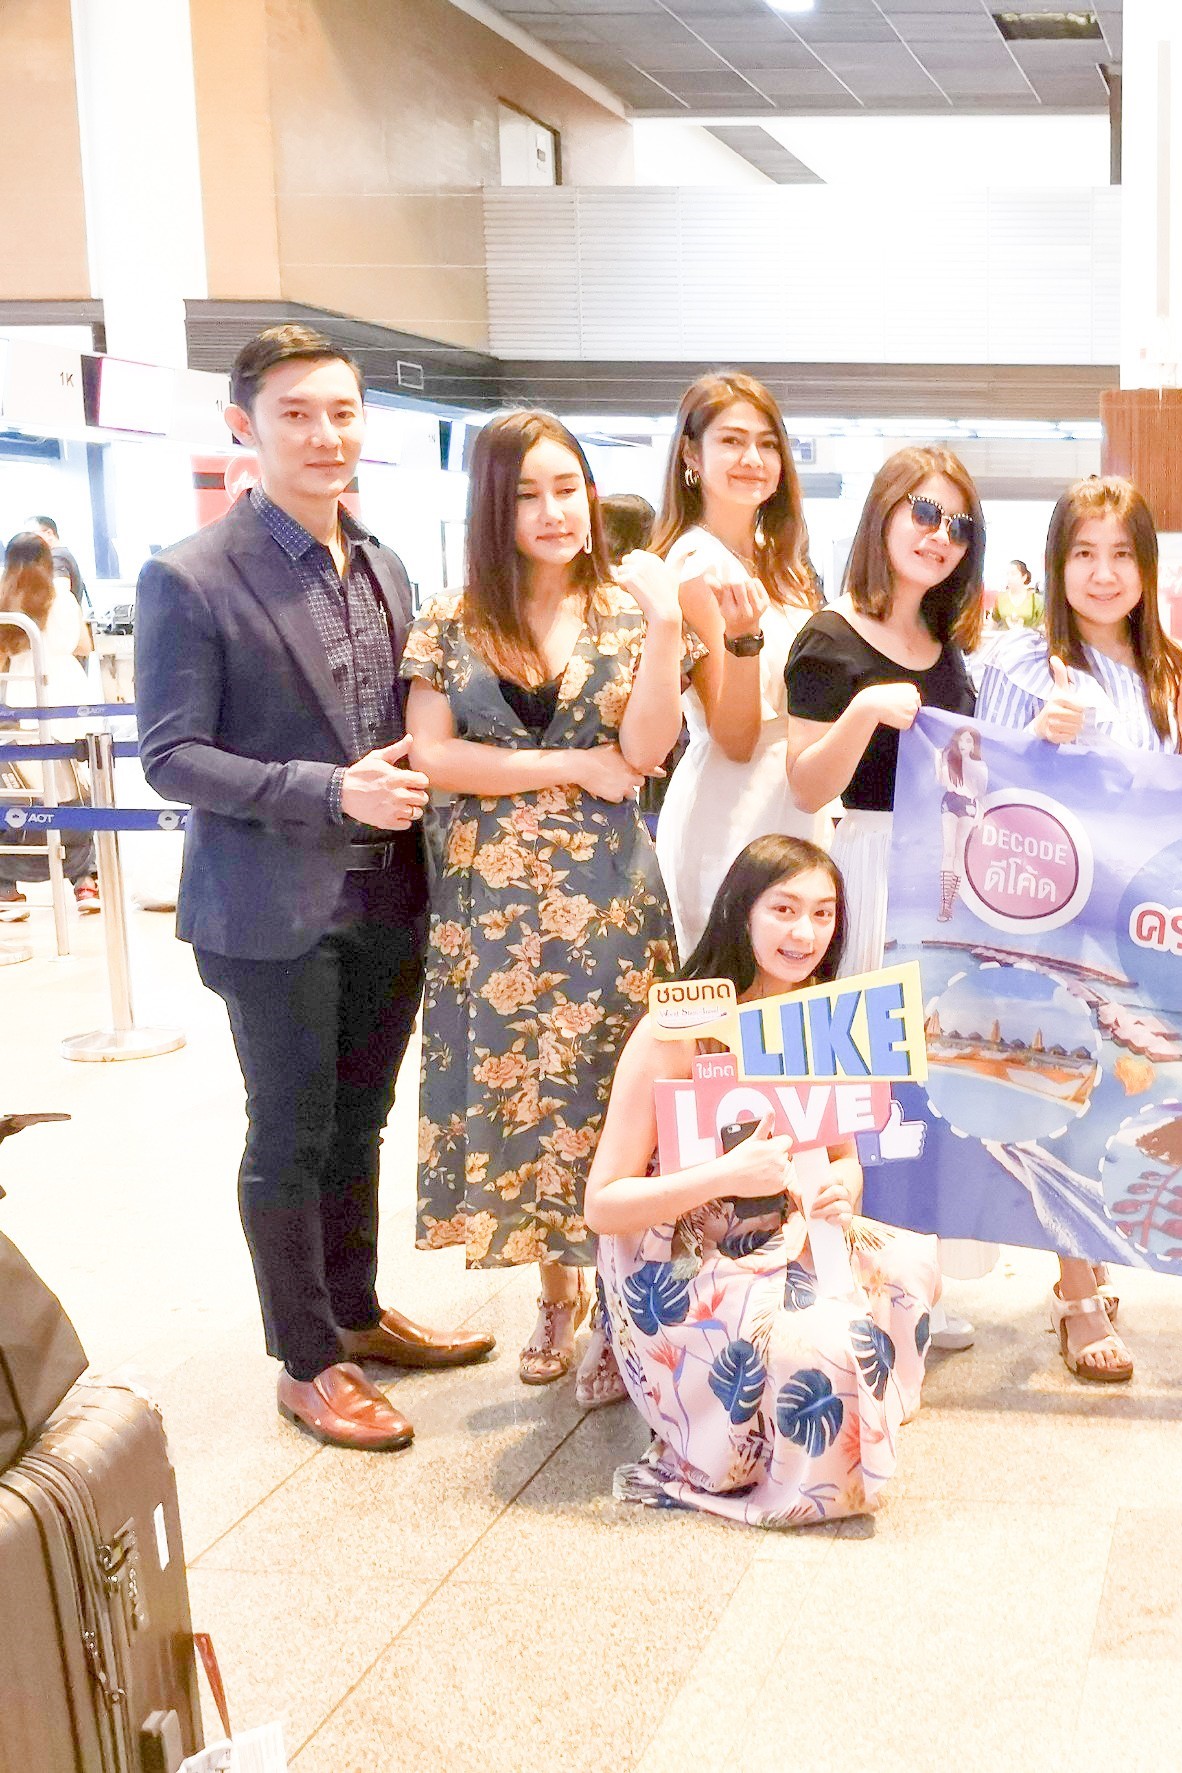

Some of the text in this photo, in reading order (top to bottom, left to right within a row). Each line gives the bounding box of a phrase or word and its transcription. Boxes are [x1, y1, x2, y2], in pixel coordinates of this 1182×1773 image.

[59, 371, 74, 388] 1K
[27, 813, 55, 824] AOT
[981, 824, 1069, 865] DECODE
[983, 857, 1057, 903] ดีโค้ด
[657, 983, 731, 1004] ชอบกด
[739, 983, 913, 1079] LIKE
[674, 1083, 877, 1169] LOVE
